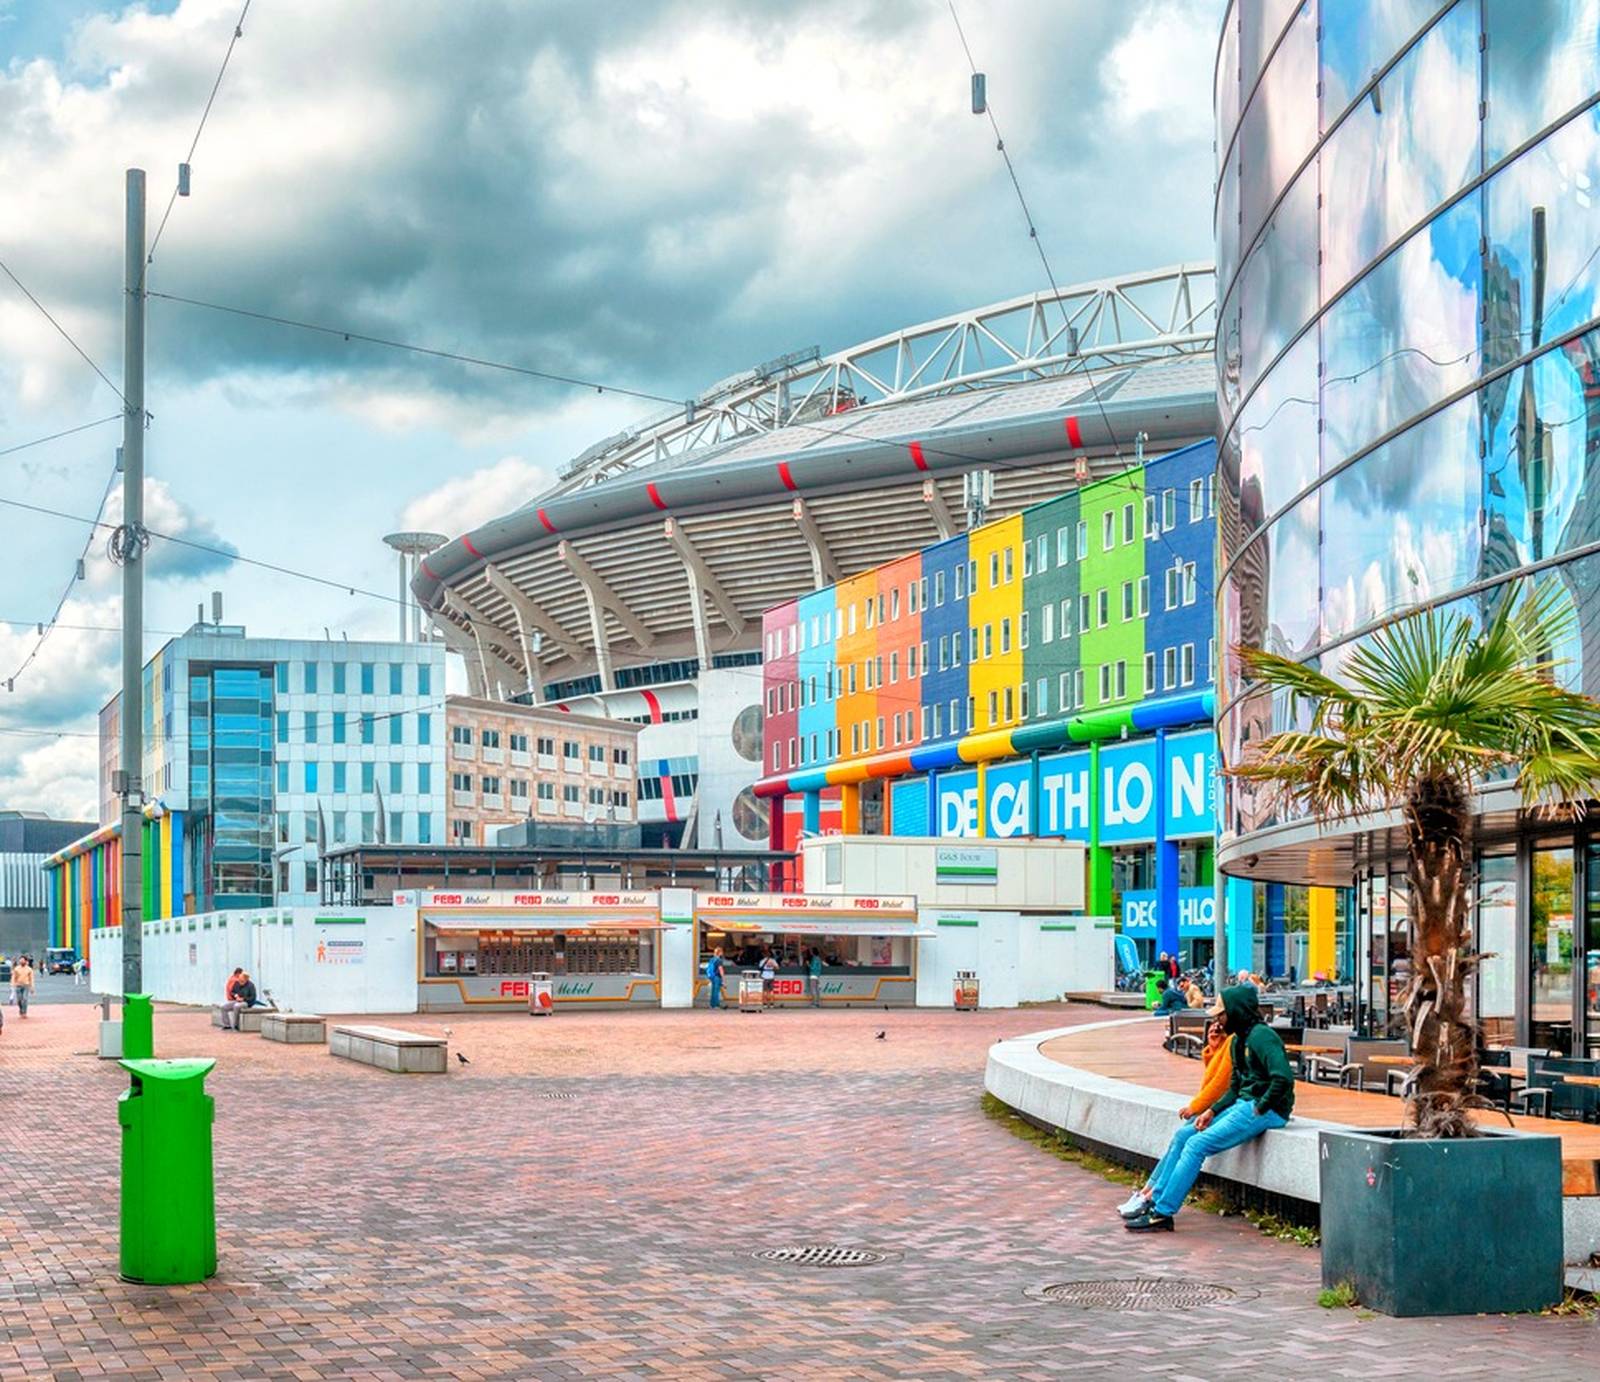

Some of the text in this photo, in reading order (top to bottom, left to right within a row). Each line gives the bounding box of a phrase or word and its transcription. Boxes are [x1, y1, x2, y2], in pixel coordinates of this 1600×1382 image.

[434, 895, 461, 904] FEBO
[514, 895, 542, 905] FEBO
[592, 895, 619, 905] FEBO
[708, 896, 734, 906] FEBO
[782, 898, 807, 907] FEBO
[854, 899, 878, 908] FEBO
[1126, 897, 1228, 927] DECHLO
[501, 981, 529, 996] FE
[772, 980, 803, 995] EBO
